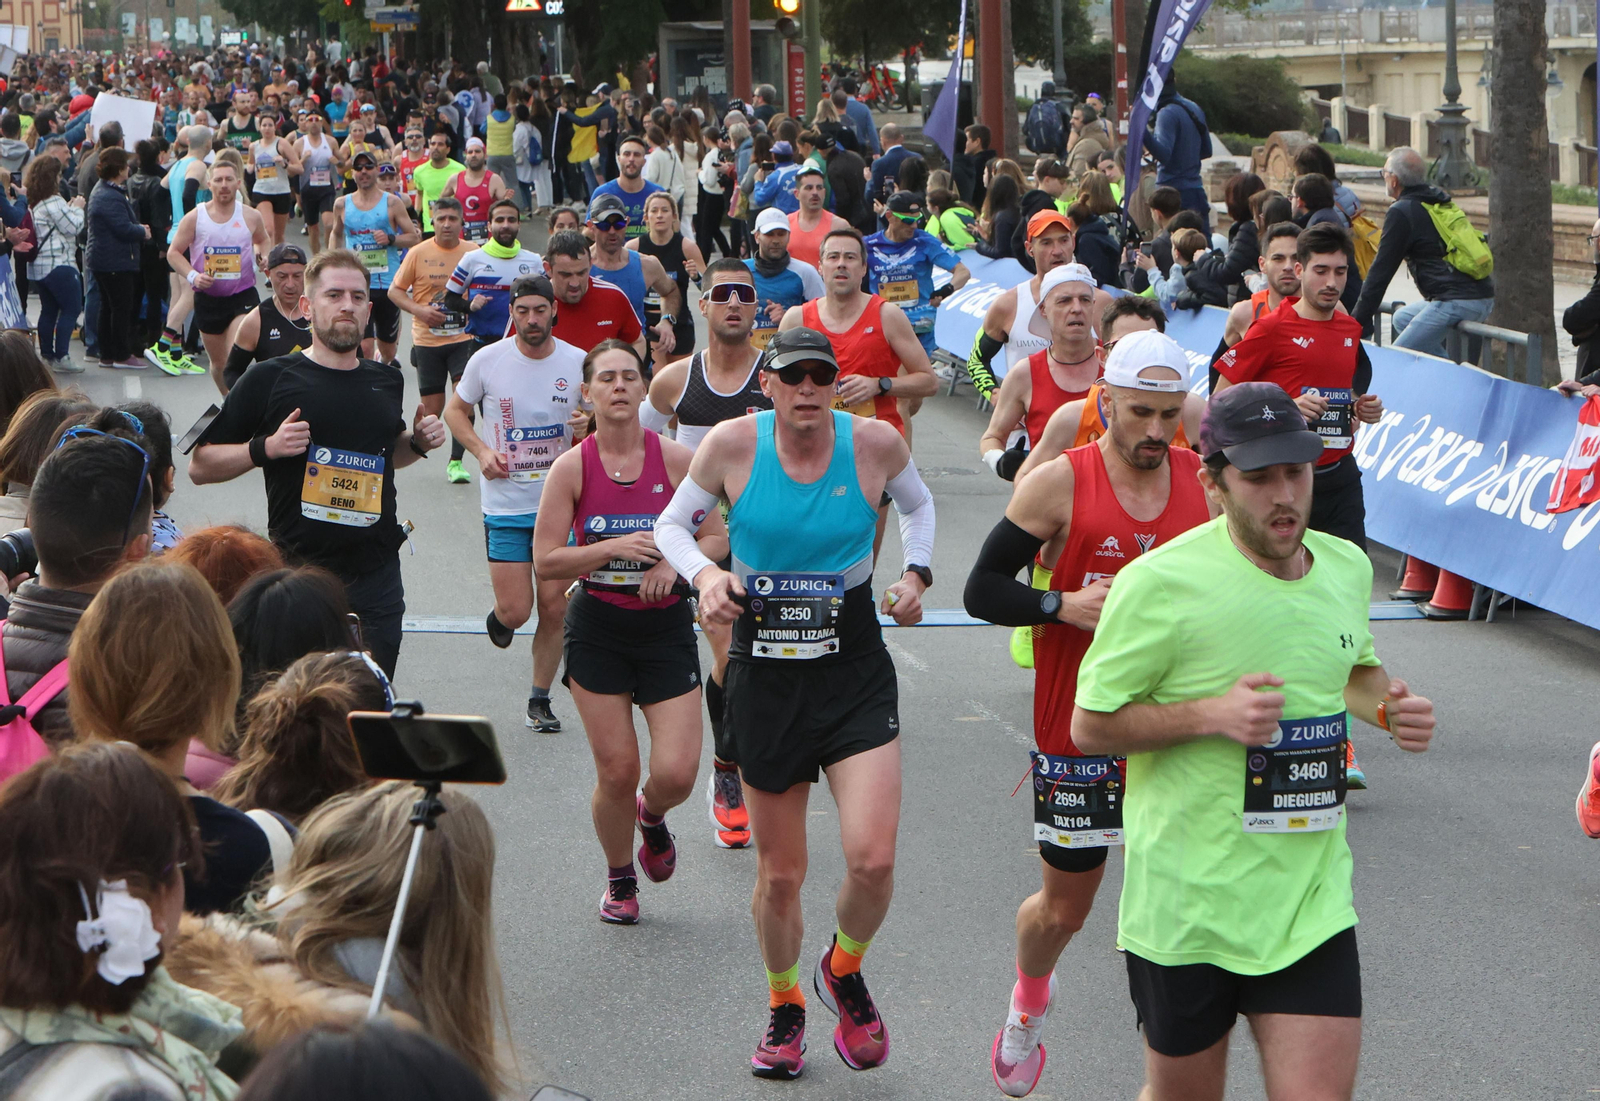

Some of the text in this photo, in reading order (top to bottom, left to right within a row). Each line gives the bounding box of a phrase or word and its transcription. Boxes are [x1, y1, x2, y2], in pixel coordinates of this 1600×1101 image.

[890, 274, 913, 282] ZURICH
[1323, 391, 1349, 400] ZURICH
[500, 397, 514, 430] GRANDE
[1321, 411, 1340, 421] 2397
[527, 427, 558, 438] ZURICH
[1316, 426, 1342, 435] BASILIO
[527, 446, 549, 456] 7404
[335, 454, 376, 469] ZURICH
[513, 462, 534, 470] TIAGO
[331, 477, 359, 491] 5424
[330, 497, 355, 508] BENO
[611, 519, 654, 529] ZURICH
[609, 561, 641, 570] HAYLEY
[780, 580, 833, 591] ZURICH
[780, 607, 811, 621] 3250
[757, 628, 835, 641] ANTONIO LIZANA
[1290, 720, 1342, 741] ZURICH
[1053, 762, 1108, 776] ZURICH
[1288, 761, 1328, 781] 3460
[1054, 791, 1086, 807] 2694
[1273, 789, 1337, 809] DIEGUEMA
[1053, 814, 1092, 828] TAX104
